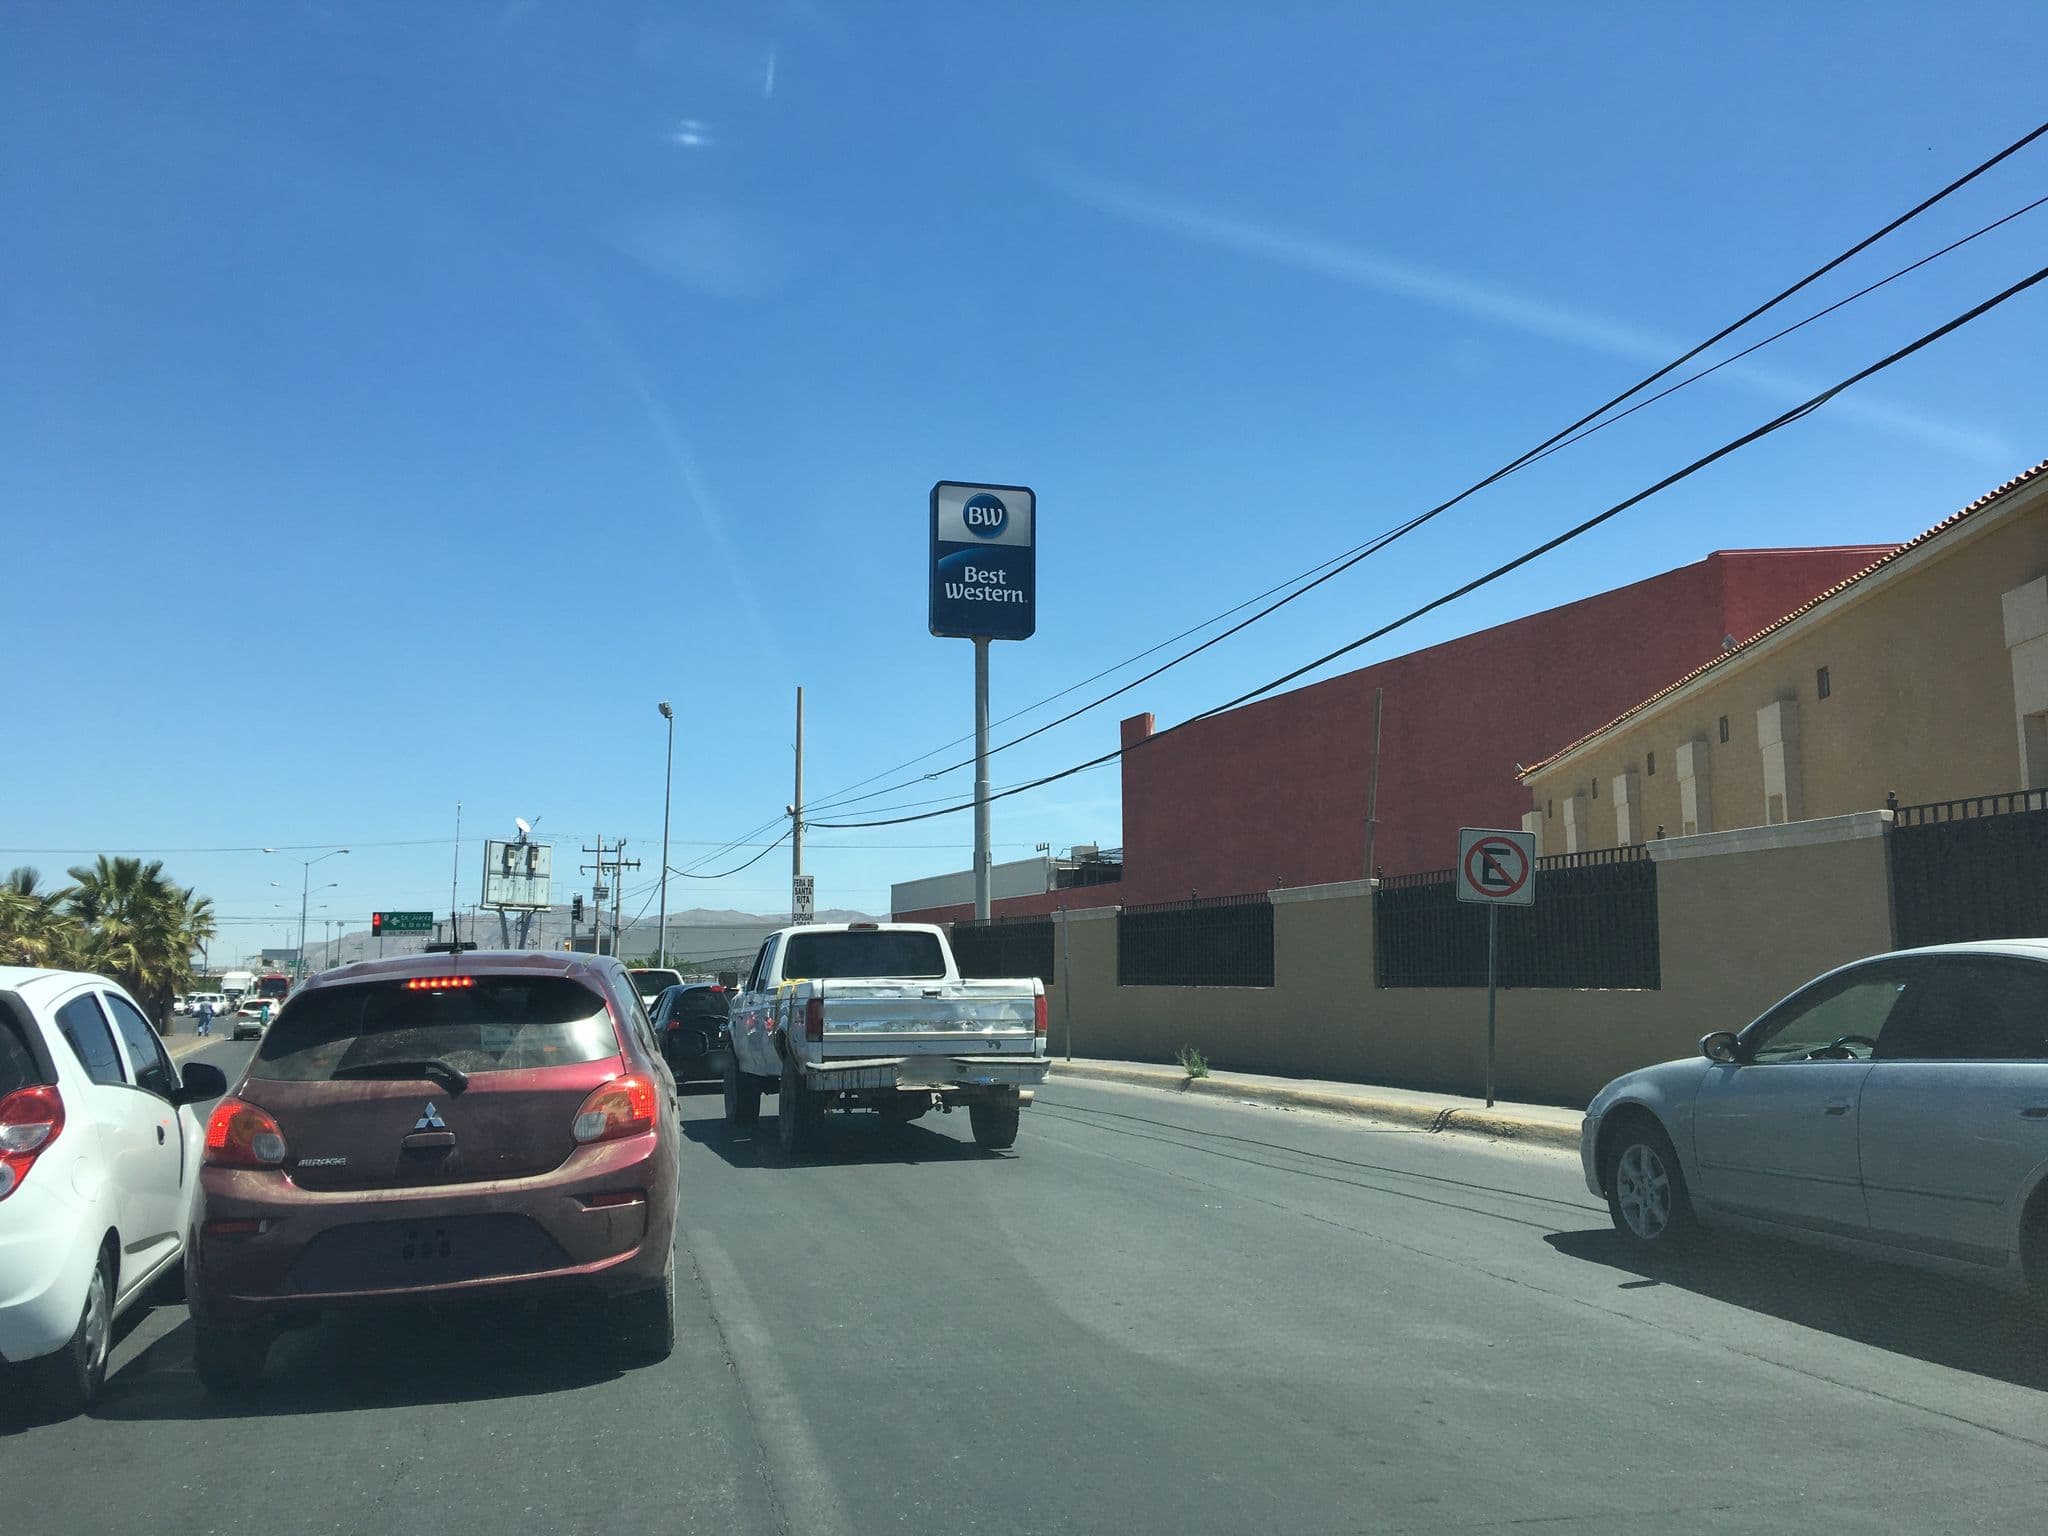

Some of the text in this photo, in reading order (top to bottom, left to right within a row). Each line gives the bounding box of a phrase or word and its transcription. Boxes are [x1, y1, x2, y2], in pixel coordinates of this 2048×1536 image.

[968, 506, 1003, 527] BW
[964, 566, 1007, 585] Best
[945, 582, 1024, 604] Western
[1482, 847, 1511, 886] E
[794, 887, 812, 895] SANTA
[796, 895, 810, 904] RITA
[800, 904, 806, 912] Y
[298, 1158, 347, 1167] MIRAGE
